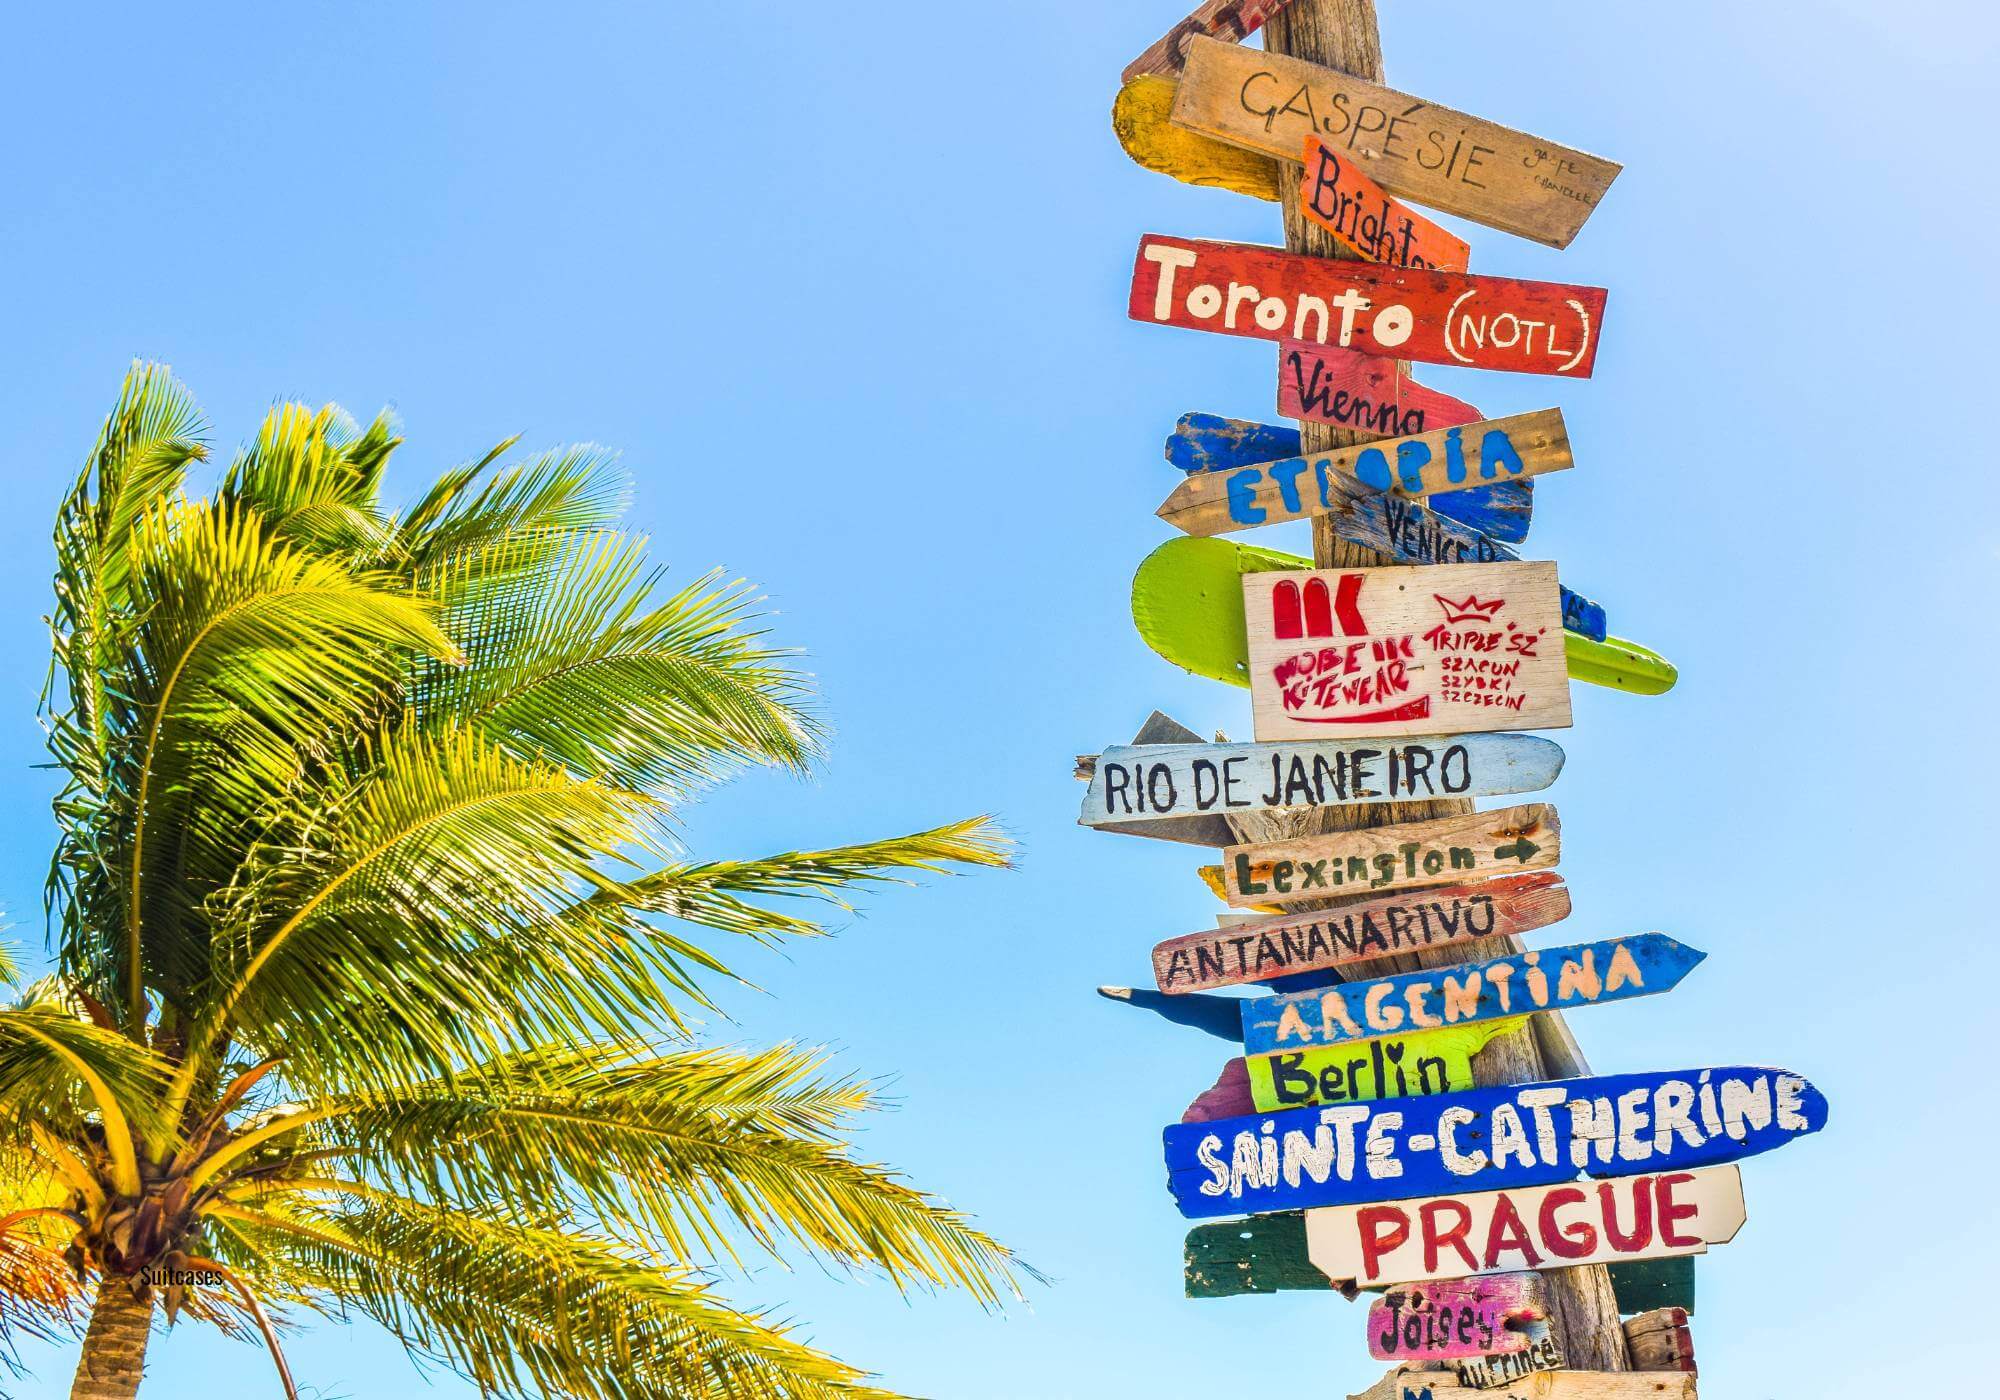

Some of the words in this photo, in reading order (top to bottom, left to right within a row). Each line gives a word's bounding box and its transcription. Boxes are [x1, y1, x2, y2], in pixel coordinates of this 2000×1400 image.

[1144, 243, 1413, 348] Toronto
[1444, 289, 1590, 371] (NOTL)
[1287, 350, 1425, 435] Vienna
[1105, 762, 1178, 814] RIO
[1192, 757, 1251, 811] DE
[1262, 744, 1471, 807] JANEIRO
[1166, 895, 1496, 988] ANTANANARIVO
[1275, 943, 1644, 1042] ARGENTINA
[1269, 1040, 1451, 1104] Berlin
[1356, 1172, 1704, 1281] PRAGUE
